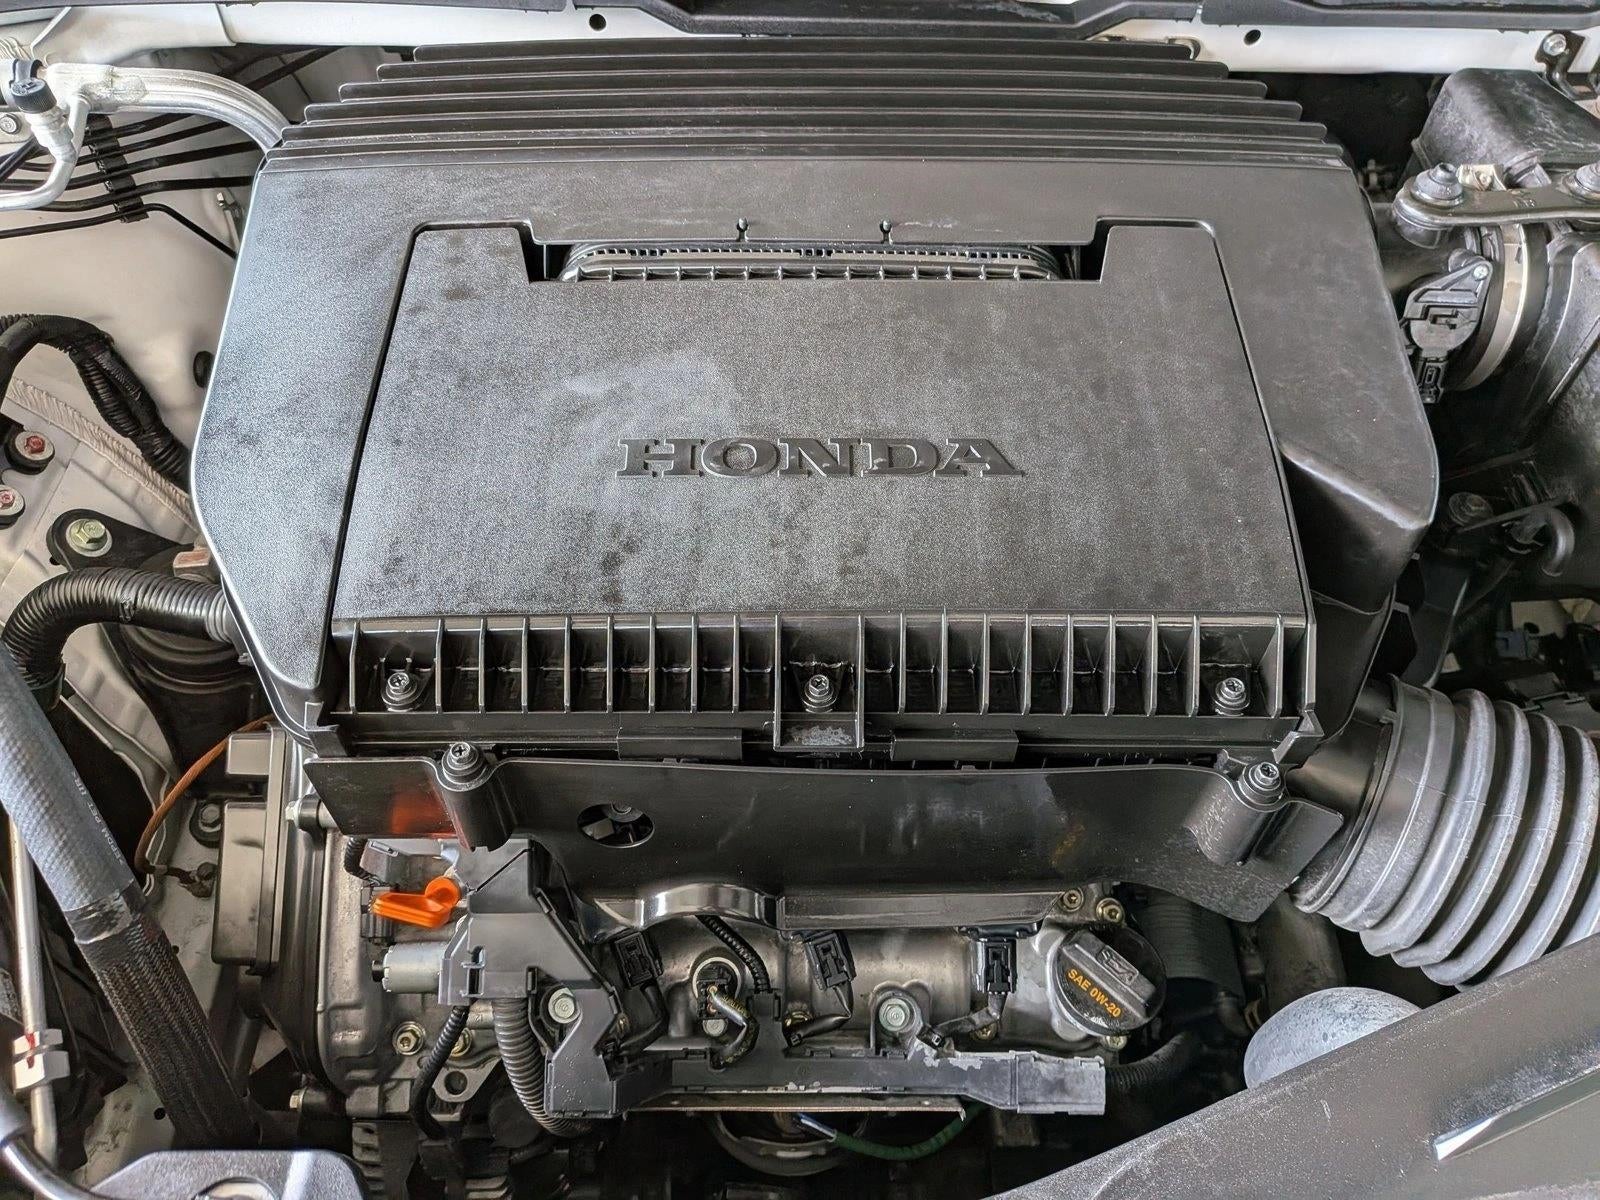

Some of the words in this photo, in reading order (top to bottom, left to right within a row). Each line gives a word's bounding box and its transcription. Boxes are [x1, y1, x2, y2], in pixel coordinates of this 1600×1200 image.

[615, 437, 1026, 478] HONDA
[1067, 968, 1092, 991] SAE
[1089, 987, 1121, 1018] 0W-20
